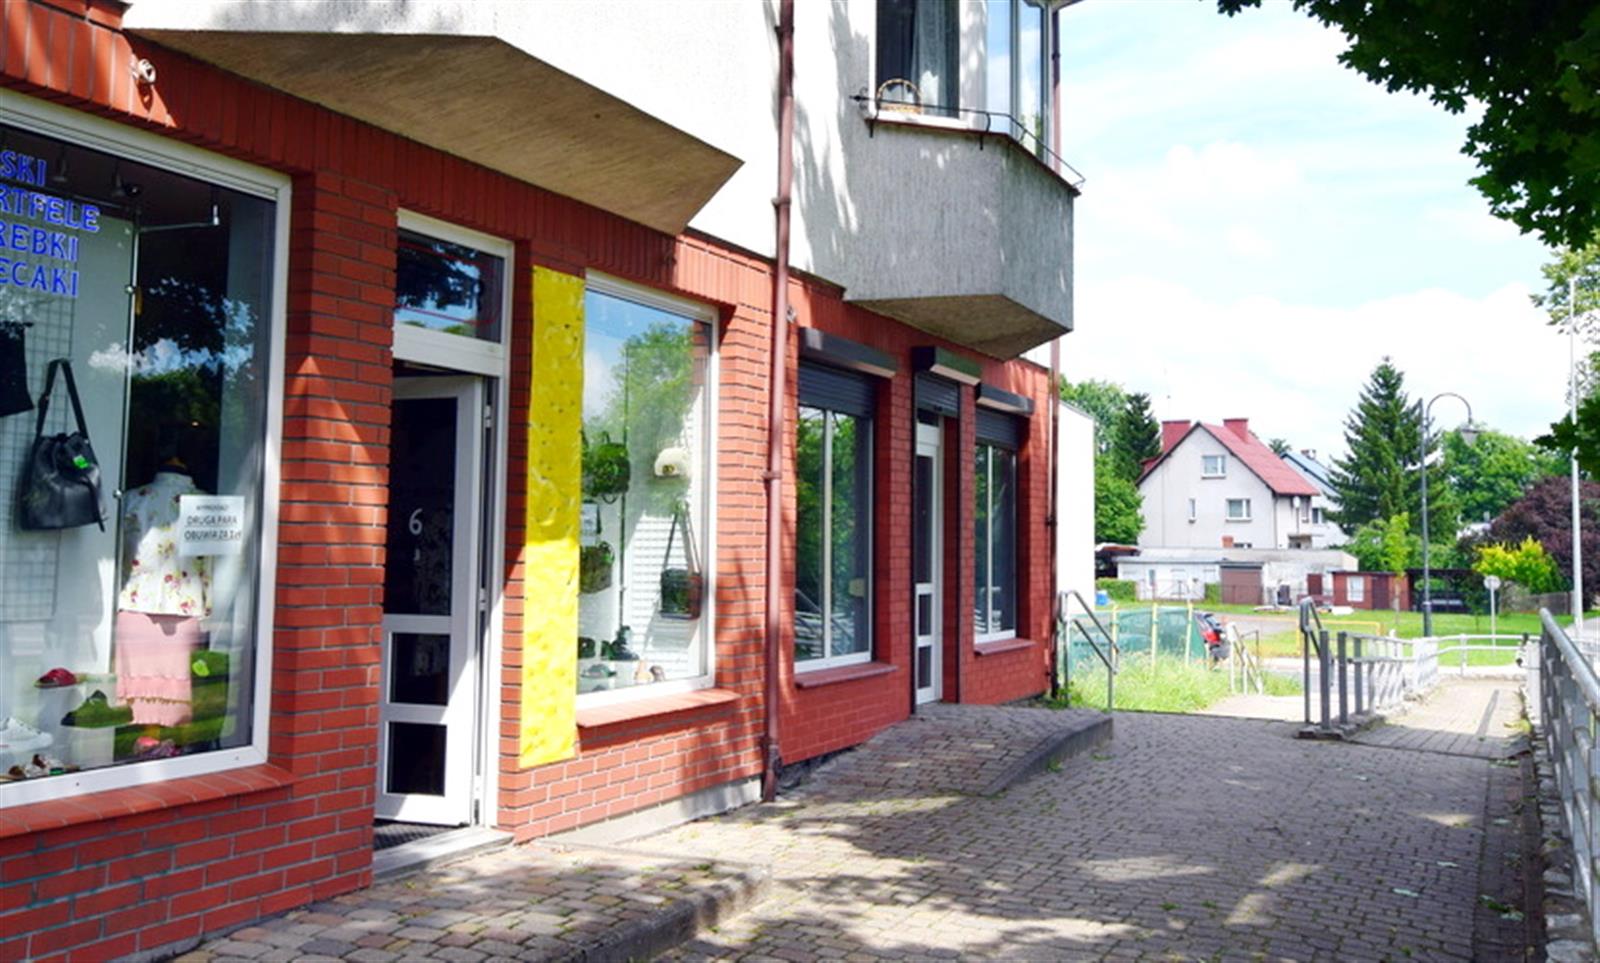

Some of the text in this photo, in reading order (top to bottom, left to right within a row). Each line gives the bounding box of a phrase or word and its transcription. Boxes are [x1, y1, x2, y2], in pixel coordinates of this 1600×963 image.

[0, 150, 47, 187] SKI
[187, 515, 238, 526] DRUGA PARA
[409, 508, 423, 535] 6
